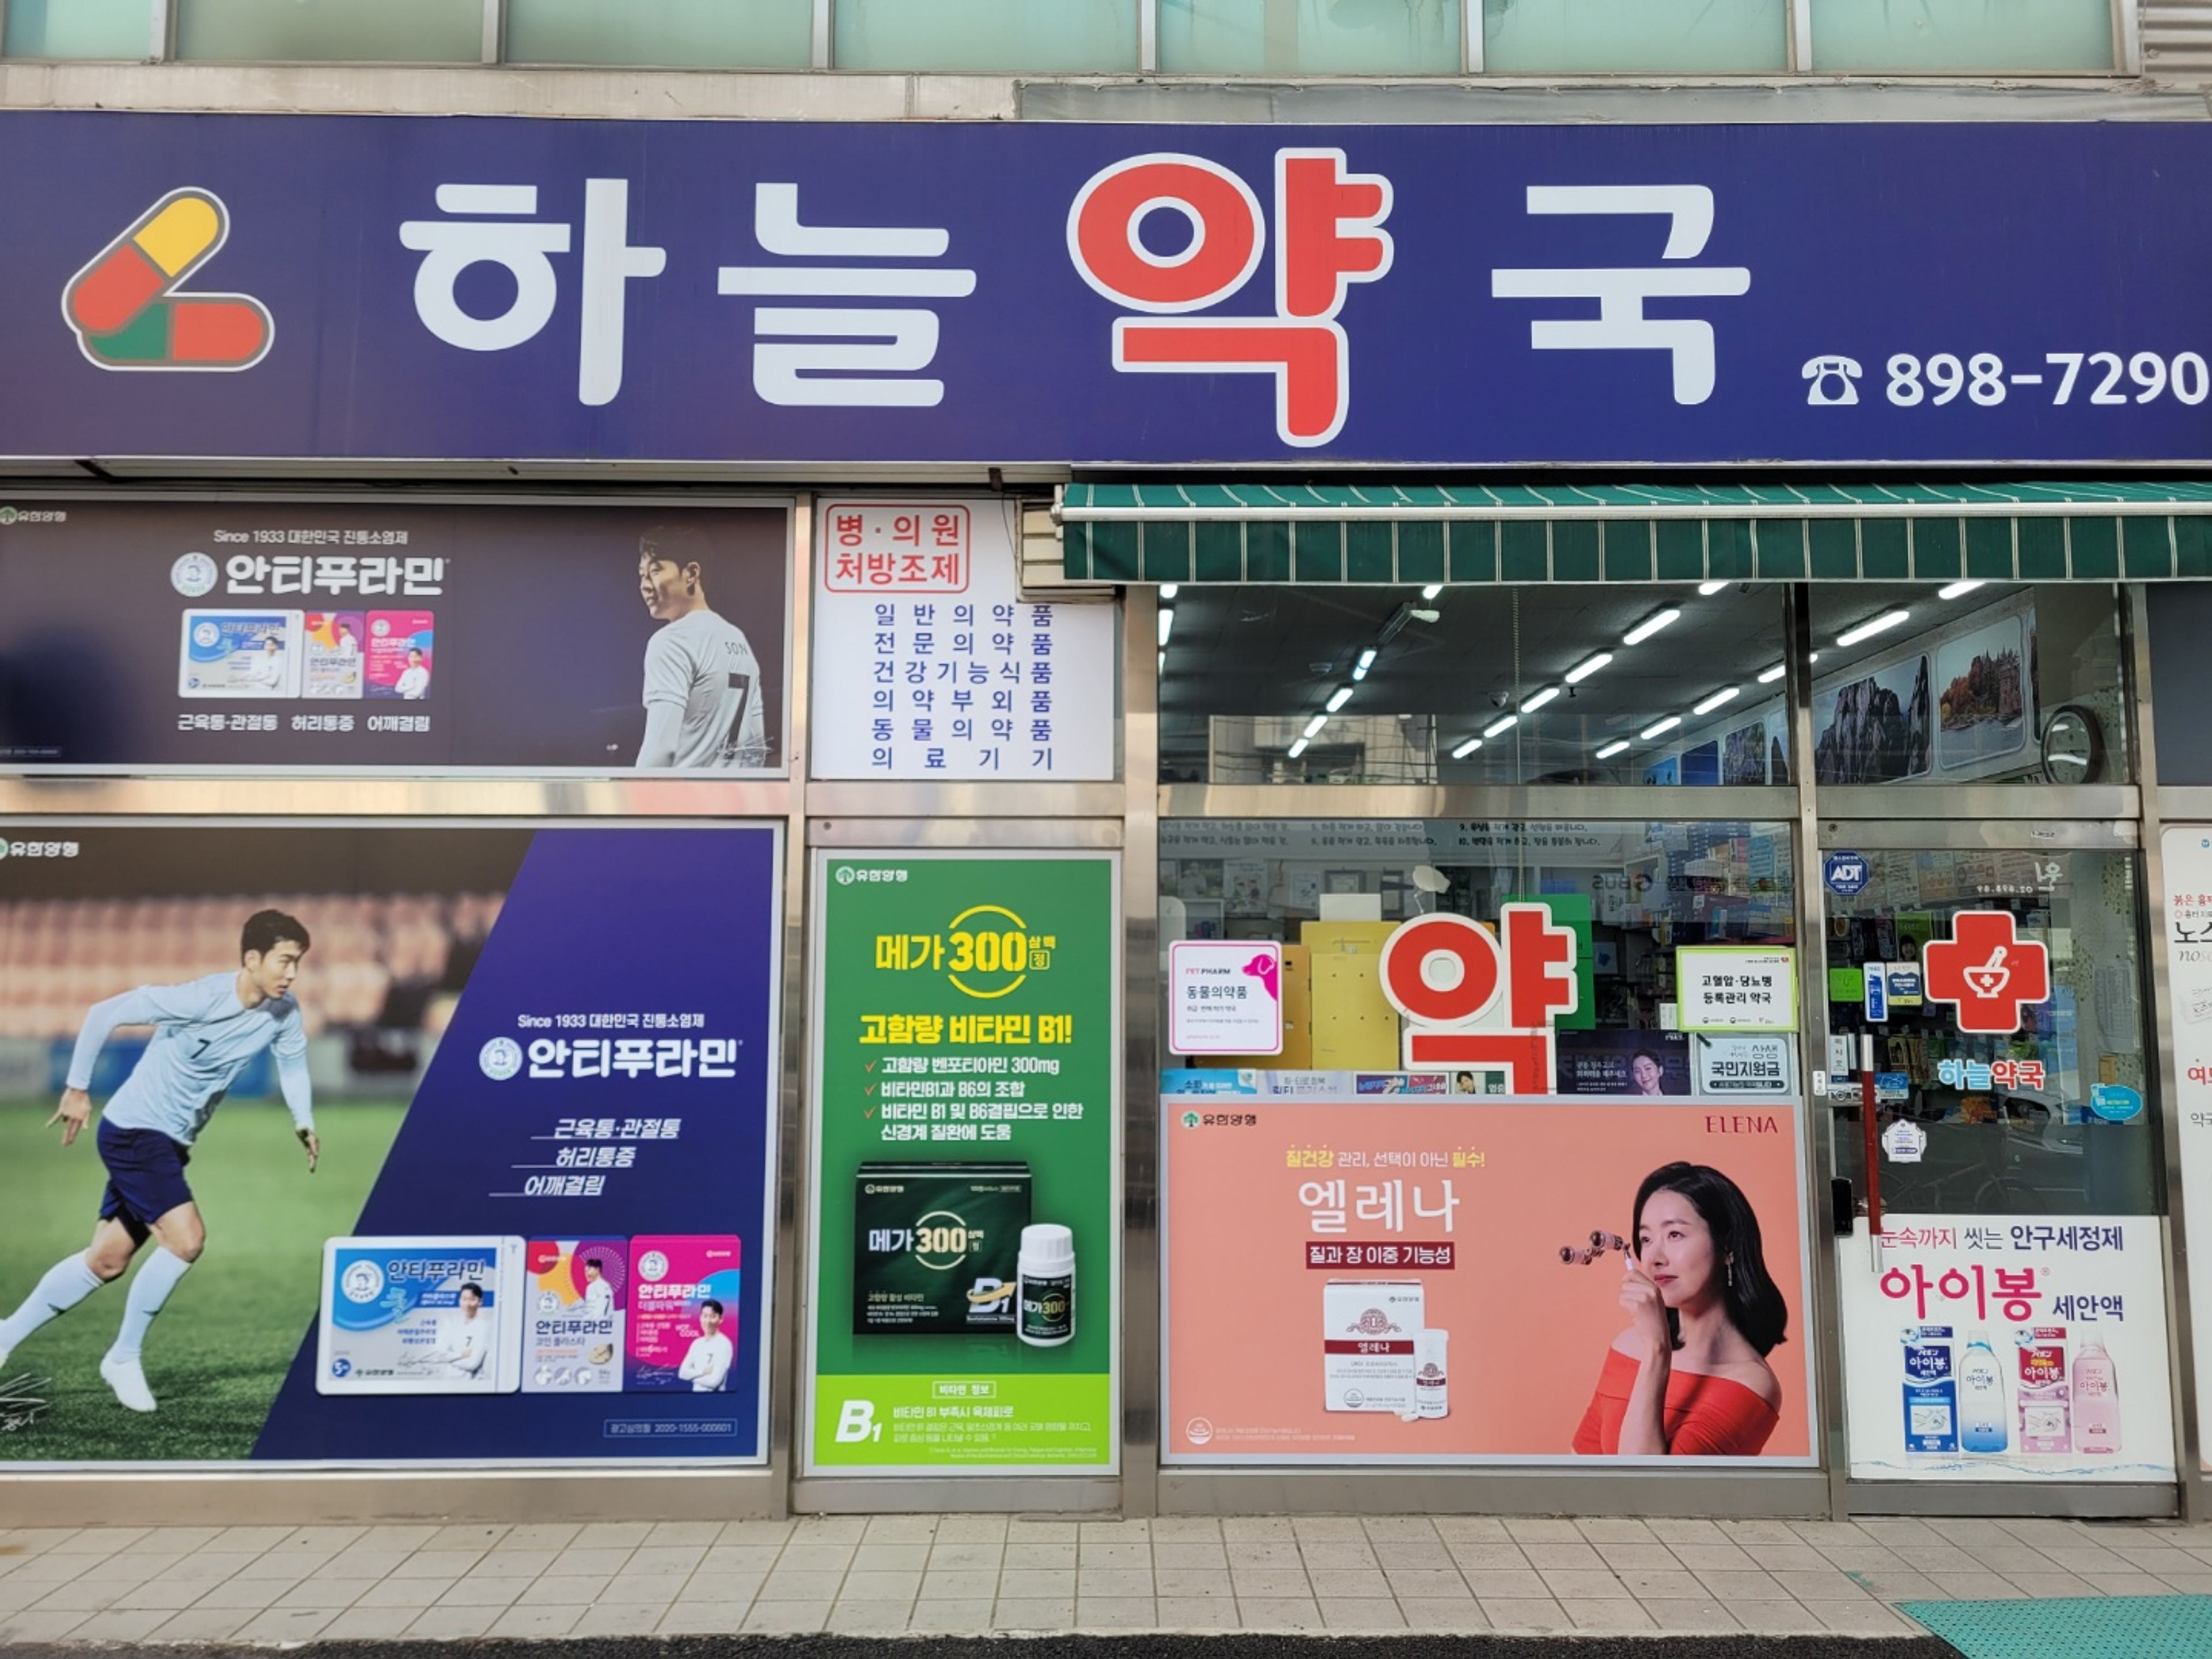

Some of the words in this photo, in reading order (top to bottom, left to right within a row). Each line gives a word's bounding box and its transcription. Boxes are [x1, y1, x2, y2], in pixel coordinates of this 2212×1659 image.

[400, 147, 1751, 448] 하늘약국
[1887, 352, 2209, 407] 898-7290
[214, 530, 248, 543] Since
[253, 531, 285, 543] 1933
[288, 530, 340, 544] 대한민국
[836, 554, 959, 585] 처방조제
[726, 642, 748, 656] SON
[291, 715, 355, 731] 허리통증
[367, 715, 430, 731] 어깨결림
[727, 673, 750, 759] 7
[1831, 865, 1862, 881] ADT
[1187, 986, 1247, 999] 동물의약품
[1380, 903, 1578, 1094] 약
[1703, 993, 1746, 1004] 등록관리
[1750, 993, 1772, 1004] 약국
[517, 1014, 551, 1028] Since
[555, 1014, 586, 1027] 1933
[589, 1014, 639, 1028] 대한민국
[642, 1014, 704, 1028] 진통소염제
[860, 1014, 944, 1044] 고함량
[949, 1014, 1031, 1044] 비타민
[1038, 1014, 1072, 1043] B1!
[191, 1039, 211, 1059] 7
[882, 1057, 928, 1074] 고함량
[931, 1057, 1007, 1074] 벤포티아민
[1011, 1058, 1059, 1075] 300mg
[1711, 1062, 1780, 1076] 국민지원금
[1938, 1060, 2044, 1090] 하늘약국
[958, 1081, 991, 1098] B6의
[994, 1081, 1025, 1098] 조합
[881, 1103, 926, 1120] 비타민
[931, 1104, 945, 1119] B1
[950, 1103, 965, 1120] 및
[1052, 1103, 1083, 1120] 인한
[1203, 1114, 1257, 1126] 유한양행
[881, 1125, 927, 1141] 신경계
[930, 1124, 976, 1141] 질환에
[980, 1125, 1012, 1141] 도움
[1706, 1116, 1779, 1134] ELENA
[555, 1147, 636, 1168] 허리통증
[1286, 1148, 1334, 1168] 질건강
[1338, 1152, 1370, 1168] 관리,
[1373, 1152, 1416, 1168] 선택이
[1420, 1152, 1448, 1168] 아닌
[1453, 1151, 1485, 1168] 필수!
[524, 1176, 605, 1196] 어깨결림
[1298, 1179, 1460, 1233] 엘레나
[1881, 1228, 1957, 1249] 눈속까지
[1964, 1228, 2003, 1249] 씻는
[2010, 1225, 2124, 1251] 안구세정제
[1310, 1247, 1342, 1264] 질과
[1346, 1247, 1362, 1264] 장
[1366, 1247, 1398, 1264] 이중
[1403, 1247, 1450, 1264] 기능성
[388, 1262, 484, 1281] 안티푸라민
[2052, 1295, 2124, 1321] 세안액
[536, 1320, 612, 1334] 안티푸라민
[835, 1400, 882, 1442] B1
